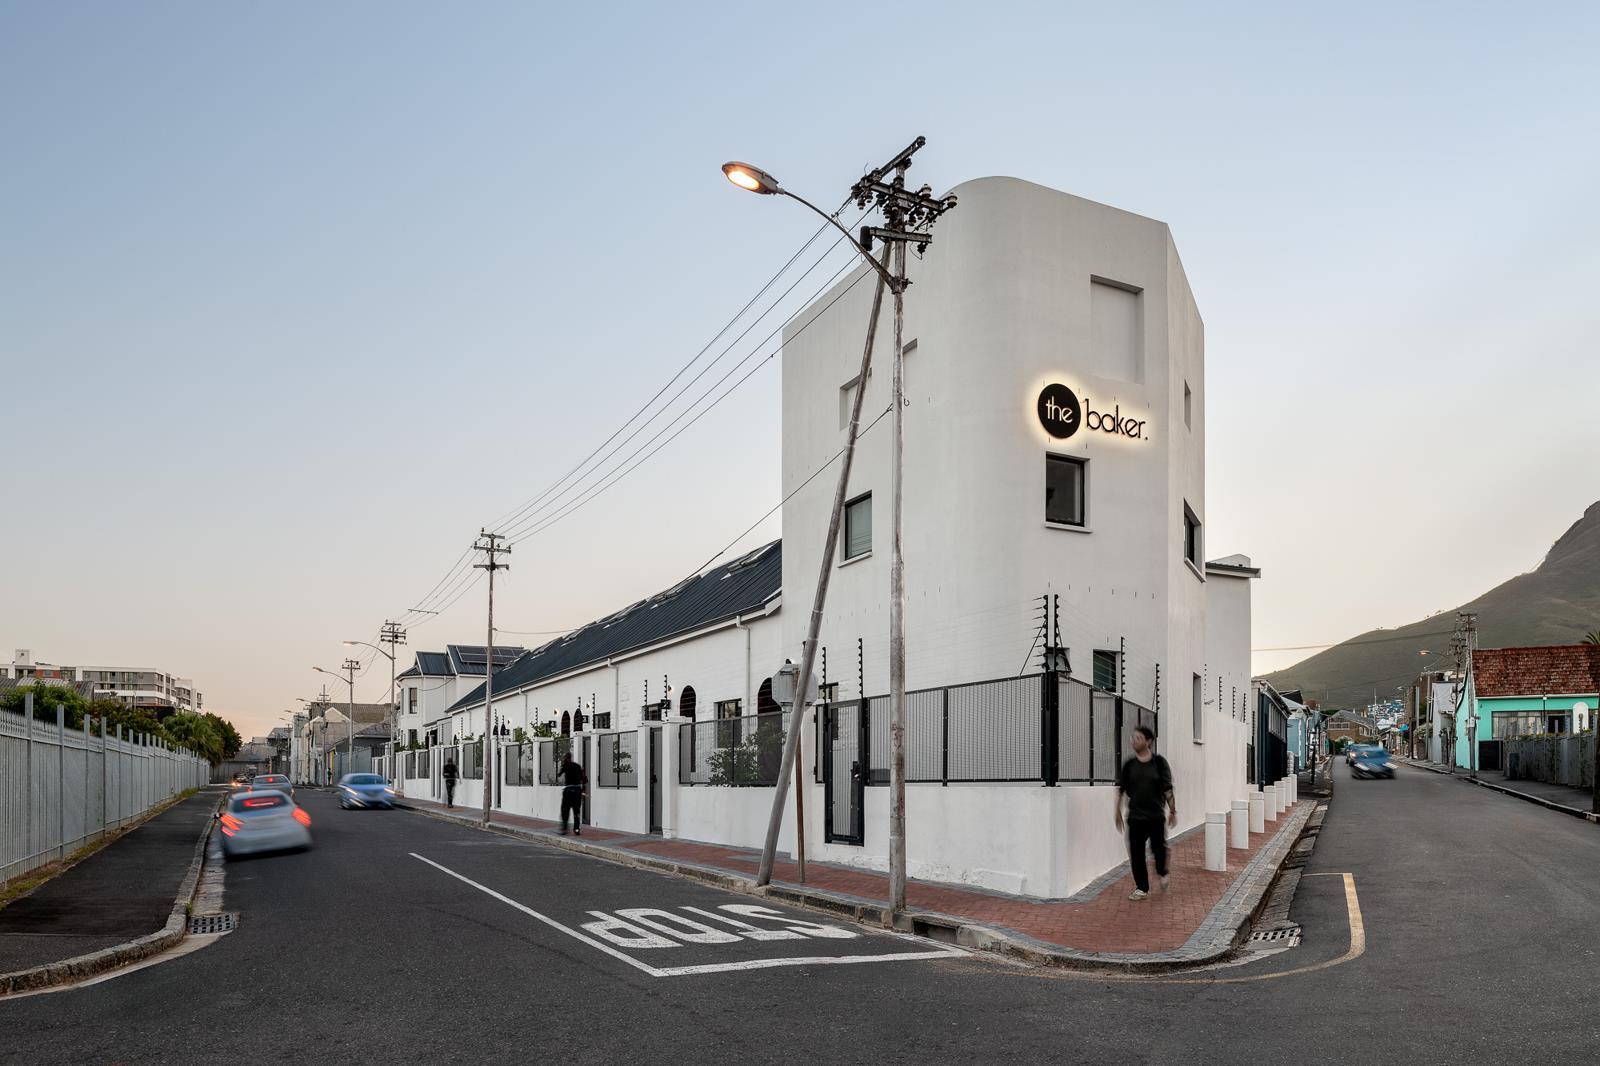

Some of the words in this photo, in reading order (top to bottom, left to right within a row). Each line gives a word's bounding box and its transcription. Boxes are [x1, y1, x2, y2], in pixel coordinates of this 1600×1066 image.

[1046, 395, 1073, 423] the
[1084, 398, 1149, 440] baker.
[579, 904, 861, 949] STOP
